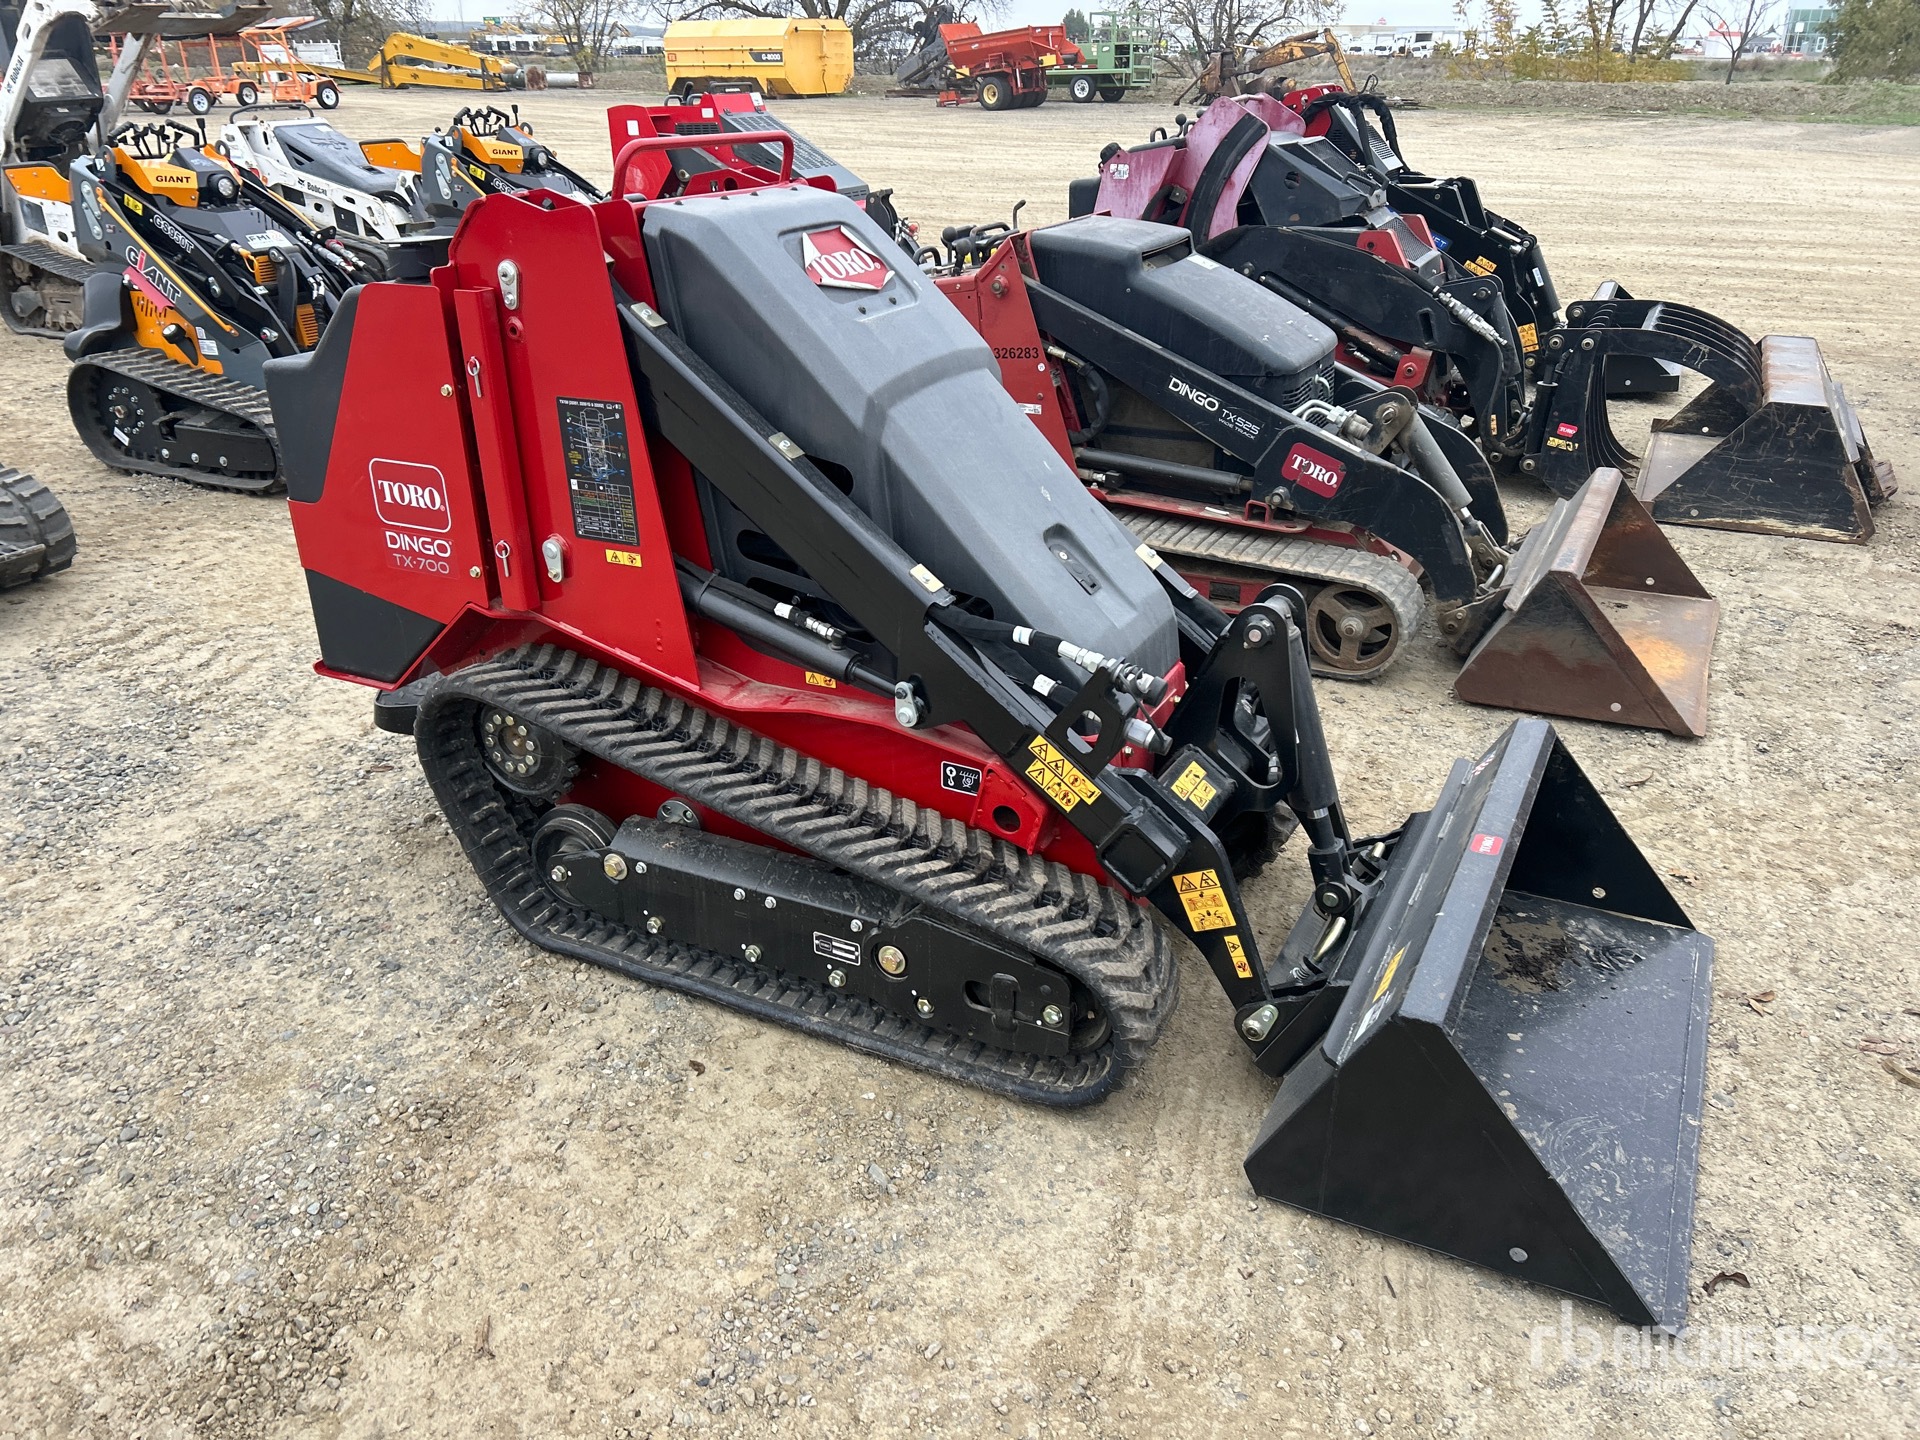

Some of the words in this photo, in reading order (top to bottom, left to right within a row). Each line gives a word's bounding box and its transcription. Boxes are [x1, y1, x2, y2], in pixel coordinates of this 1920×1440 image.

[155, 175, 191, 184] GIANT
[153, 214, 194, 254] GS950T
[807, 248, 875, 280] TORO
[993, 347, 1039, 359] 326283
[1168, 377, 1219, 412] DINGO
[1218, 417, 1235, 429] WIDE
[1234, 426, 1256, 441] TRACK
[1291, 453, 1338, 486] TORO
[378, 480, 442, 511] TORO
[385, 531, 451, 558] DINGO
